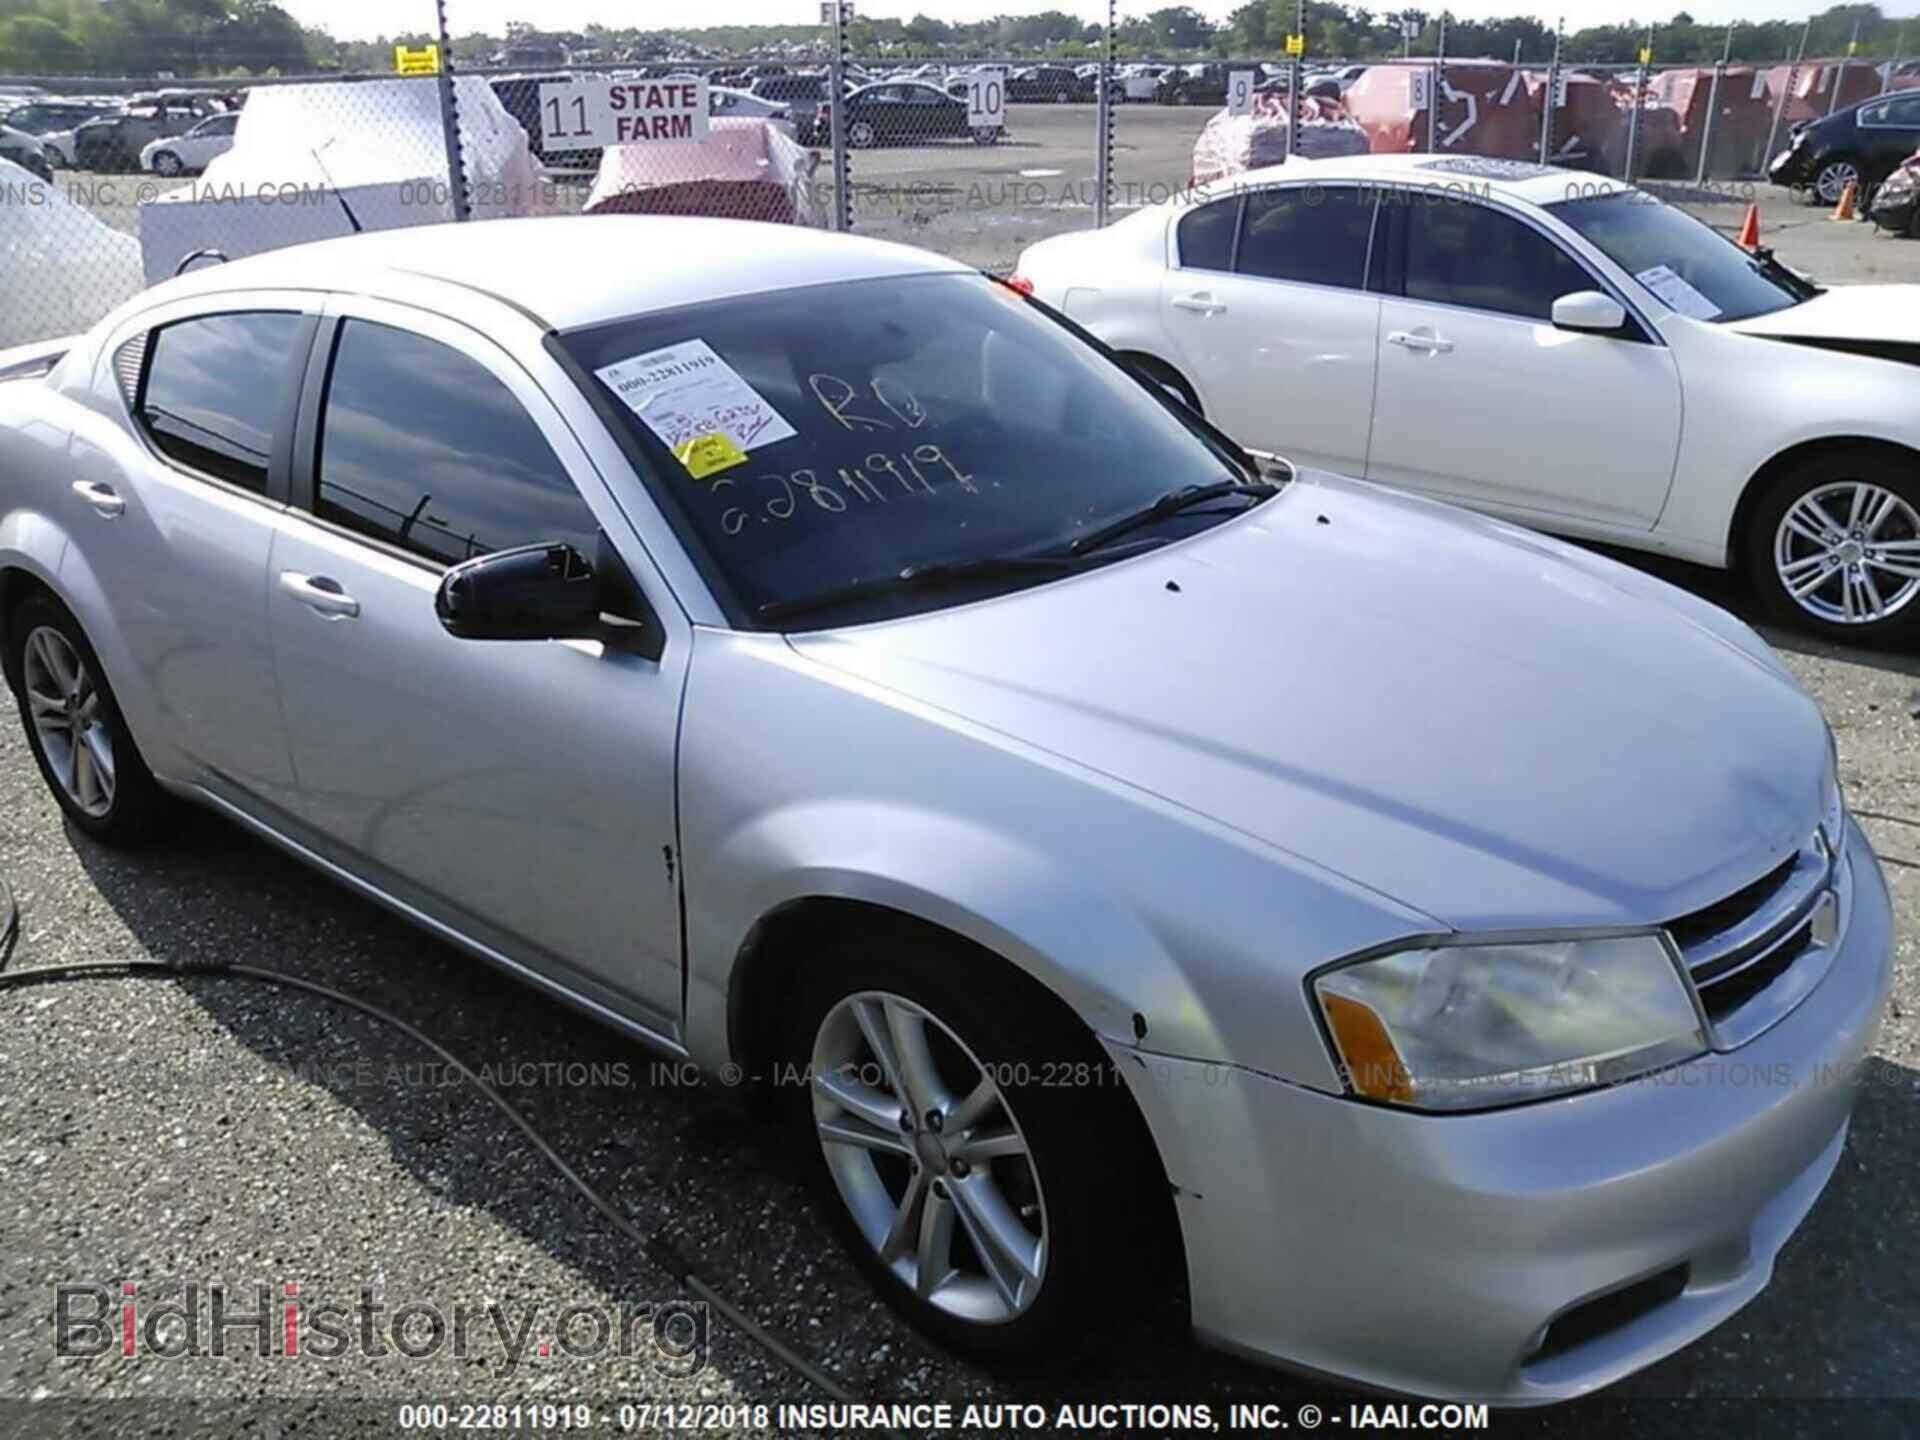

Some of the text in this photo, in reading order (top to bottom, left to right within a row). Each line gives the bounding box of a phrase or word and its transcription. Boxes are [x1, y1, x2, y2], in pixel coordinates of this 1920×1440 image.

[609, 84, 697, 110] STATE
[971, 81, 1001, 115] 10
[1236, 80, 1246, 108] 9
[546, 96, 592, 137] 11
[617, 114, 692, 141] FARM
